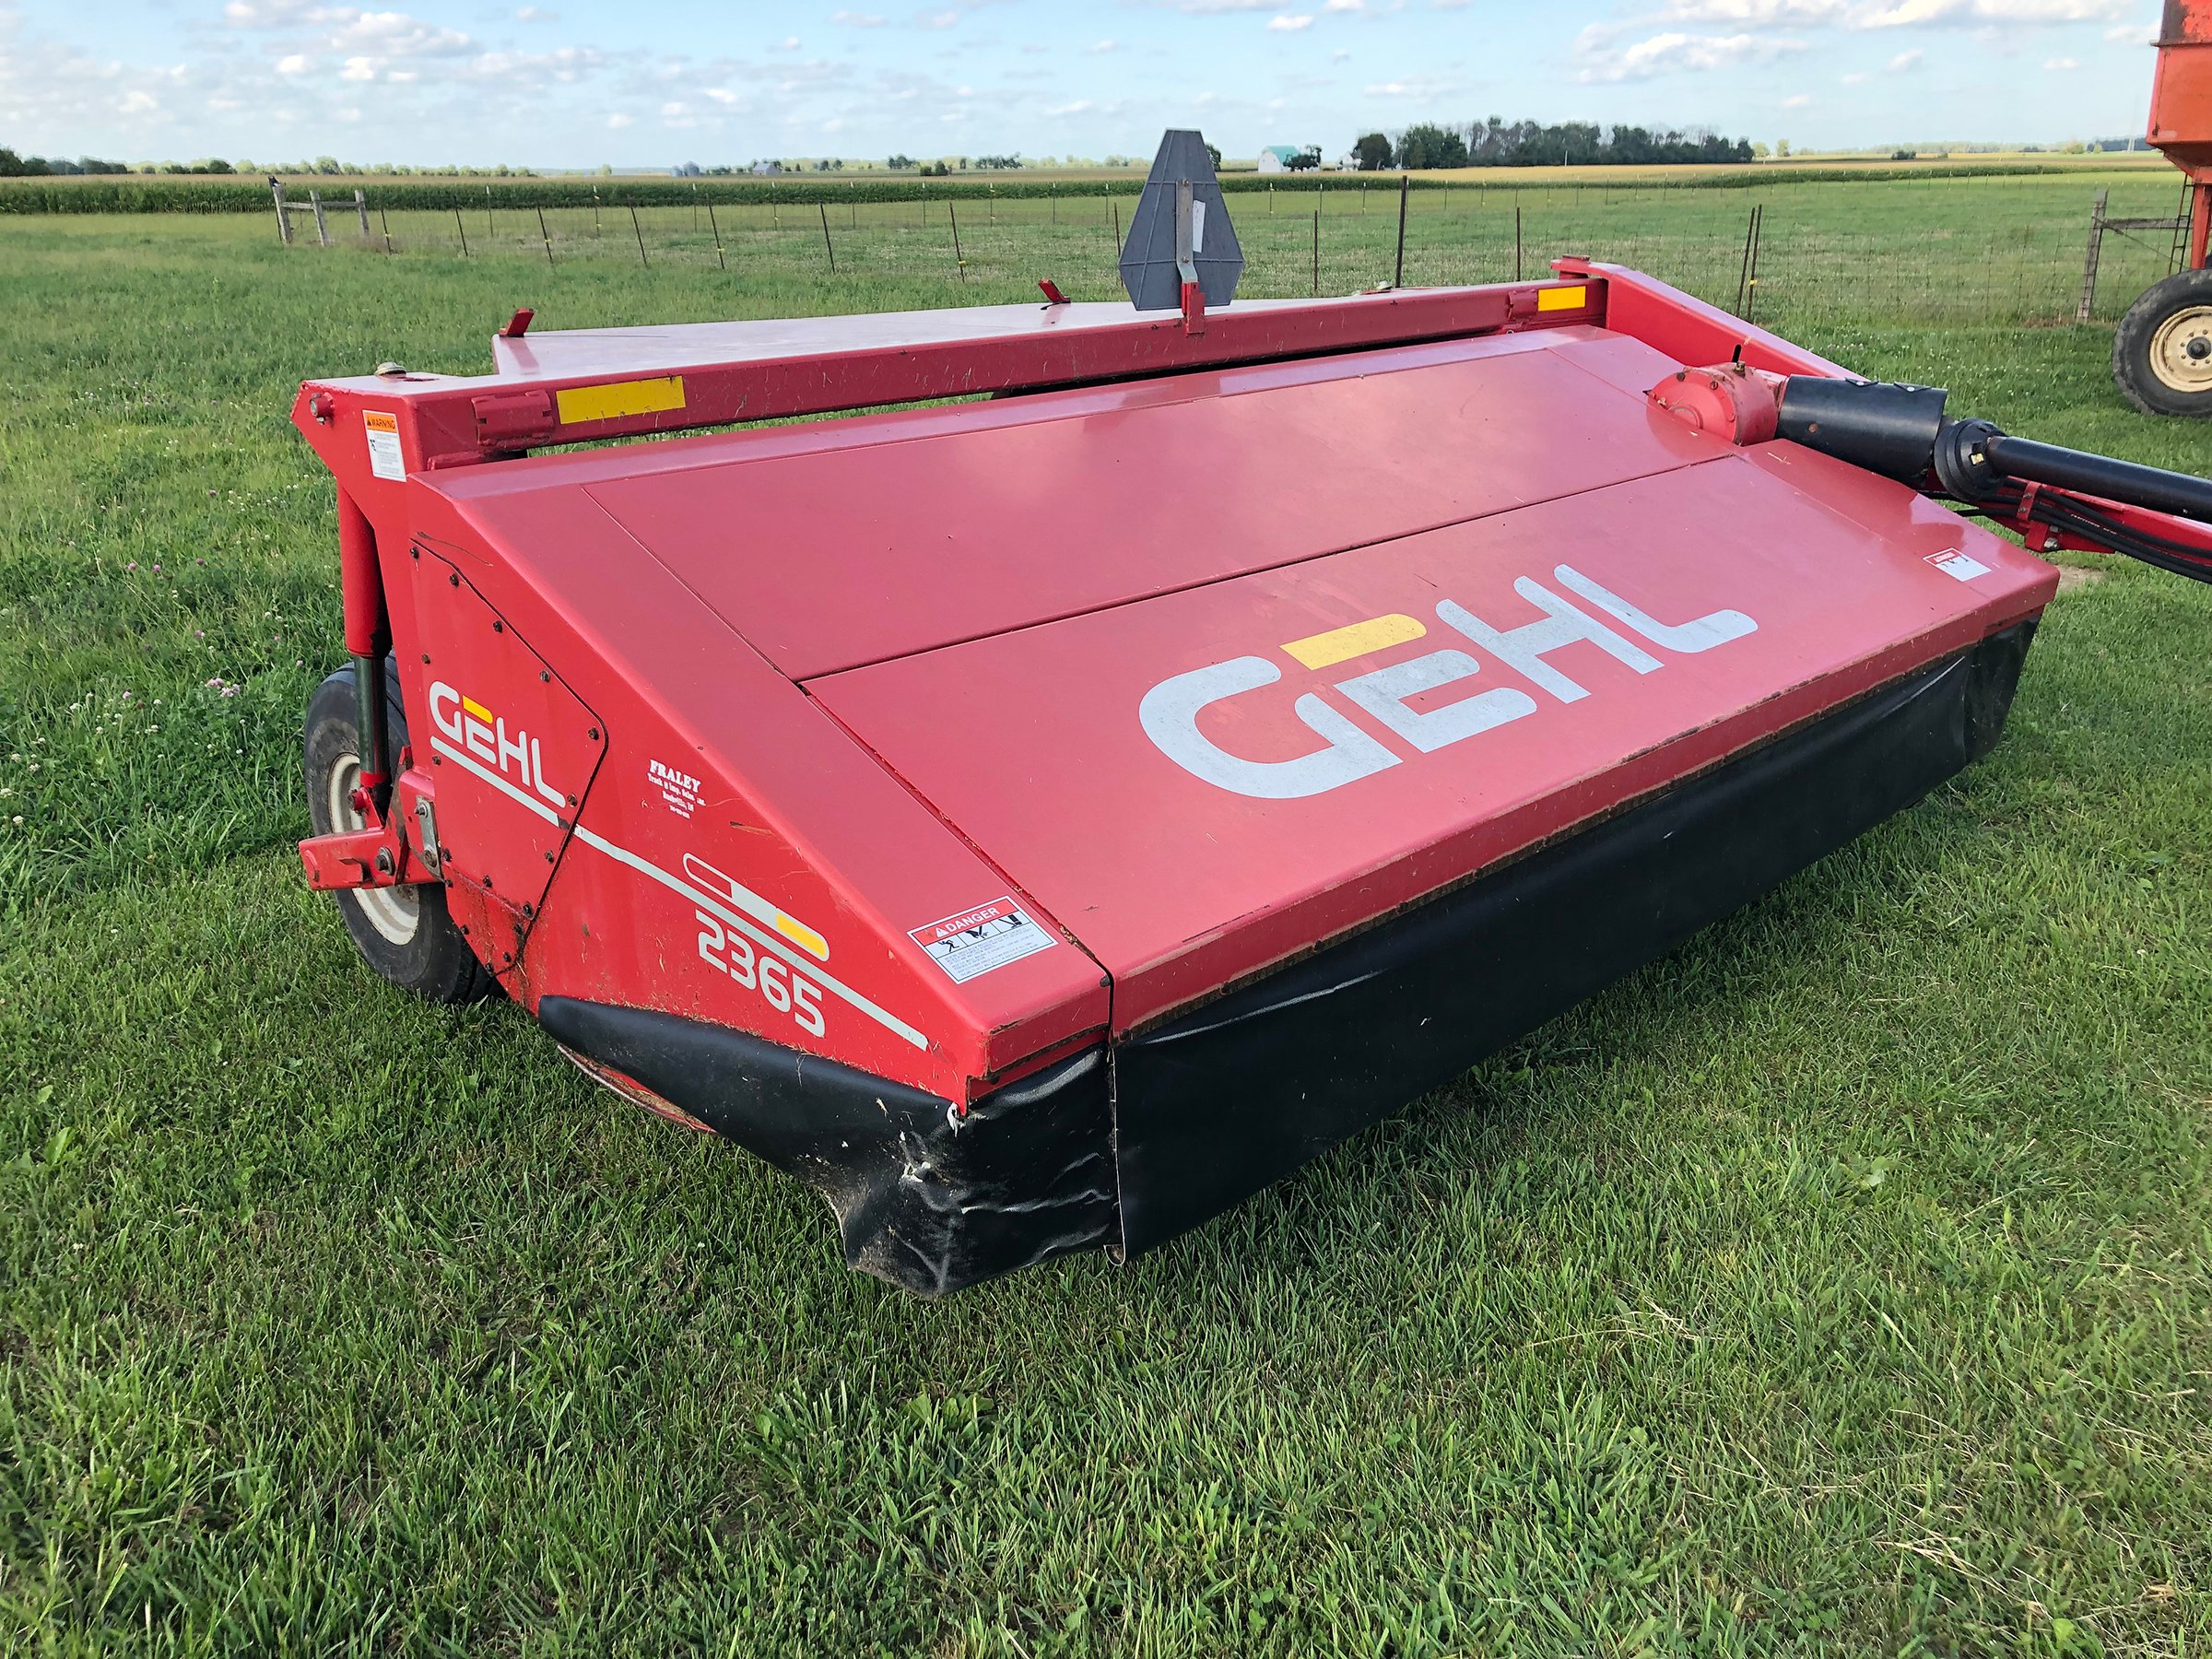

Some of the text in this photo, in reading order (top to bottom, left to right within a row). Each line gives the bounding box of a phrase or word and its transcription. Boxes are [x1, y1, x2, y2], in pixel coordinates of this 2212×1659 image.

[371, 418, 395, 429] WARNING
[1138, 563, 1759, 799] GEHL
[429, 680, 566, 808] GEHL
[649, 759, 701, 793] FRALEY
[944, 907, 1001, 933] DANGER
[695, 908, 826, 1038] 2365
